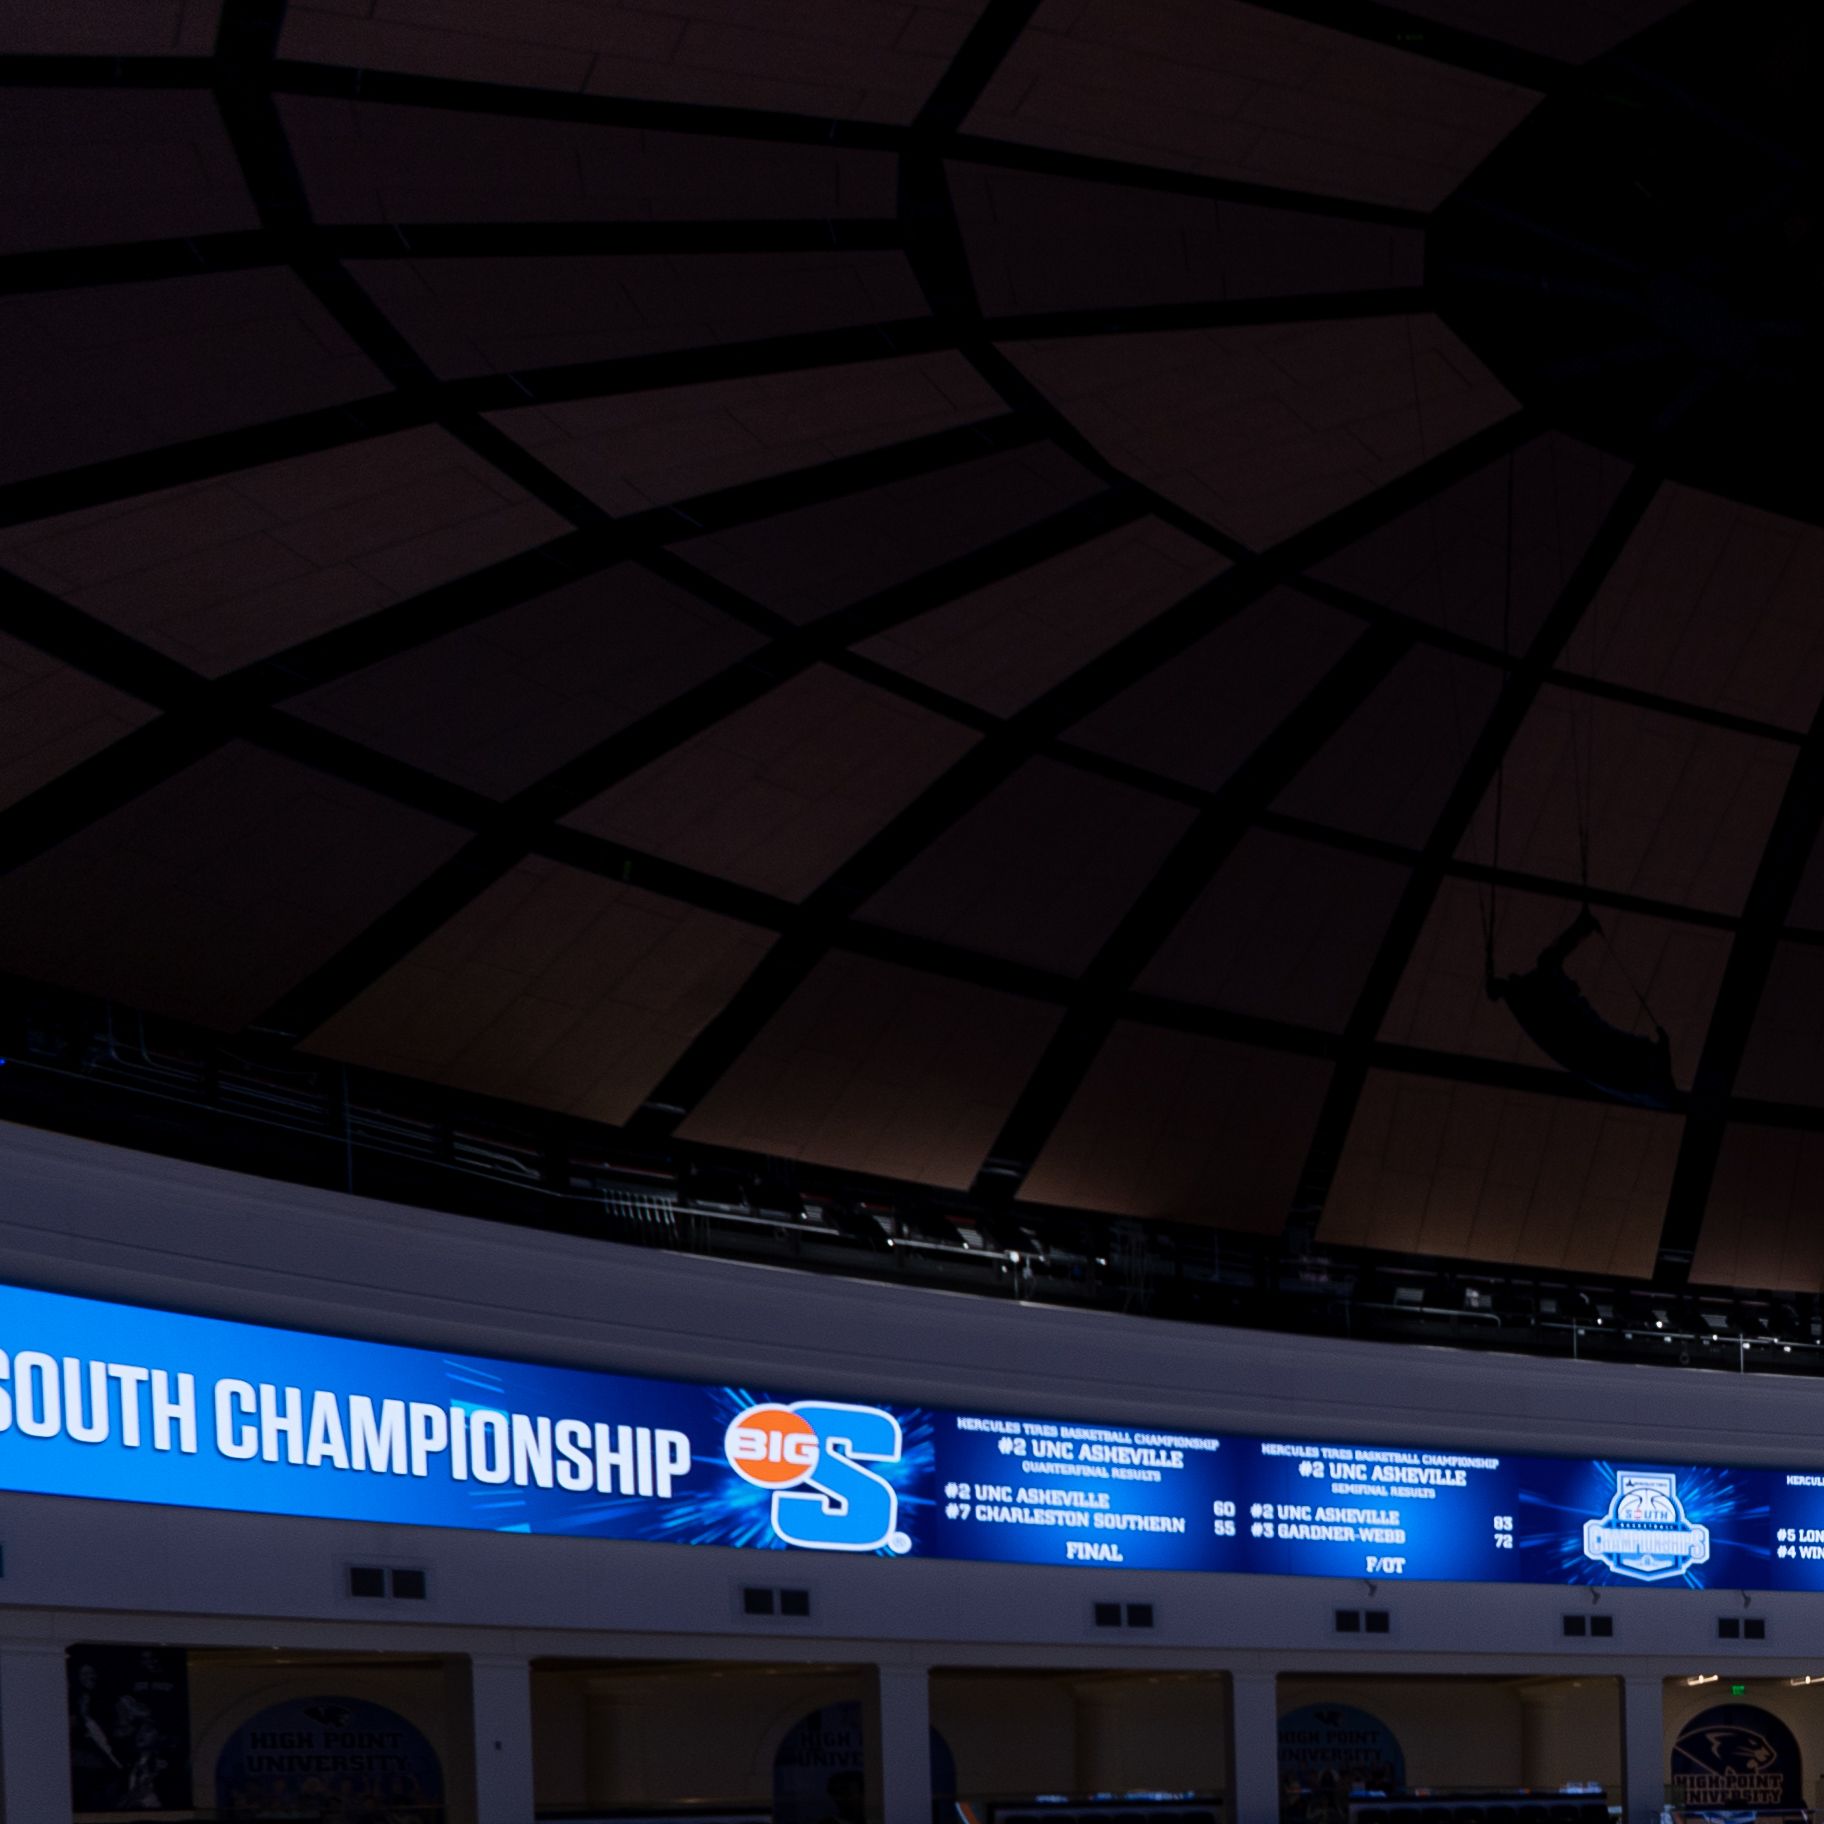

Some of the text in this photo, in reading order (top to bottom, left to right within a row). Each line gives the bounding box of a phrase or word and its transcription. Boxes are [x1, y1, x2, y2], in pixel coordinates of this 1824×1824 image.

[213, 1377, 693, 1499] CHAMPIONSHIP
[733, 1425, 821, 1468] BIG
[998, 1438, 1184, 1469] #2 UNC ASHEVILLE
[1299, 1461, 1466, 1486] #2 UNC ASHEVILLE
[975, 1484, 1110, 1509] UNC ASHEVILLE
[976, 1505, 1185, 1533] CHARLESTON SOUTHERN
[1214, 1500, 1235, 1517] 60
[1278, 1504, 1399, 1525] UNC ASHEVILLE
[1214, 1520, 1235, 1536] 55
[1278, 1524, 1405, 1544] GARDNER-WEBB
[1066, 1541, 1123, 1561] FINAL
[1726, 1773, 1783, 1789] POINT
